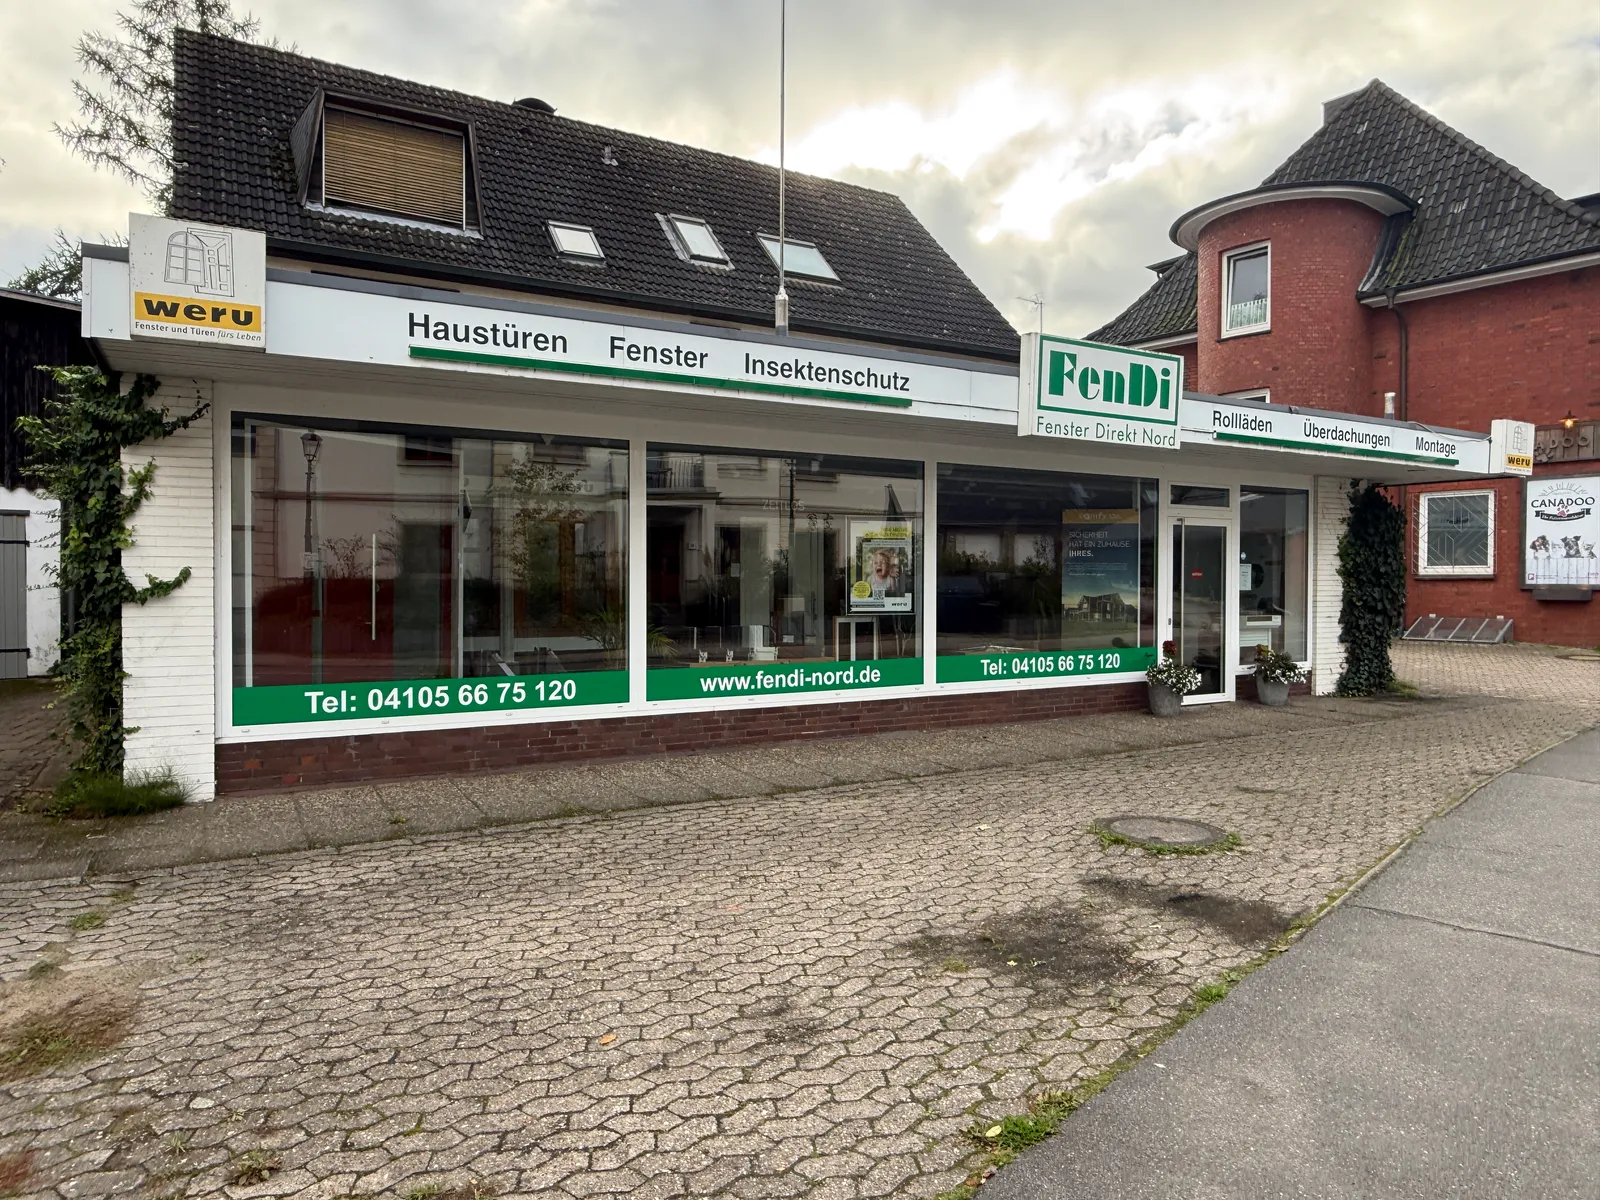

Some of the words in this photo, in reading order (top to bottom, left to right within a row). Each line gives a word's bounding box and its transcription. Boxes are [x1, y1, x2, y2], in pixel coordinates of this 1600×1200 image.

[143, 298, 253, 326] weru
[135, 321, 168, 333] Fenster
[171, 325, 188, 335] und
[190, 326, 215, 337] Türen
[216, 329, 234, 339] fürs
[236, 332, 262, 342] Leben
[408, 312, 568, 354] Haustüren
[609, 336, 709, 369] Fenster
[744, 353, 910, 392] Insektenschutz
[1049, 350, 1171, 410] FenDi
[1037, 416, 1089, 438] Fenster
[1095, 422, 1137, 444] Direkt
[1143, 428, 1176, 447] Nord
[1213, 410, 1273, 433] Rollläden
[1303, 418, 1390, 448] Überdachungen
[1415, 436, 1456, 455] Montage
[1534, 436, 1590, 450] ADOO
[1507, 456, 1531, 467] weru
[1531, 496, 1596, 508] CANADOO
[980, 659, 1007, 675] Tel:
[1012, 656, 1054, 674] 04105
[1058, 655, 1074, 671] 66
[1078, 654, 1094, 670] 75
[1098, 653, 1121, 669] 120
[700, 665, 881, 692] www.fendi-nord.de
[304, 690, 357, 714] Tel:
[367, 686, 450, 711] 04105
[458, 683, 489, 706] 66
[497, 682, 526, 703] 75
[535, 679, 577, 701] 120
